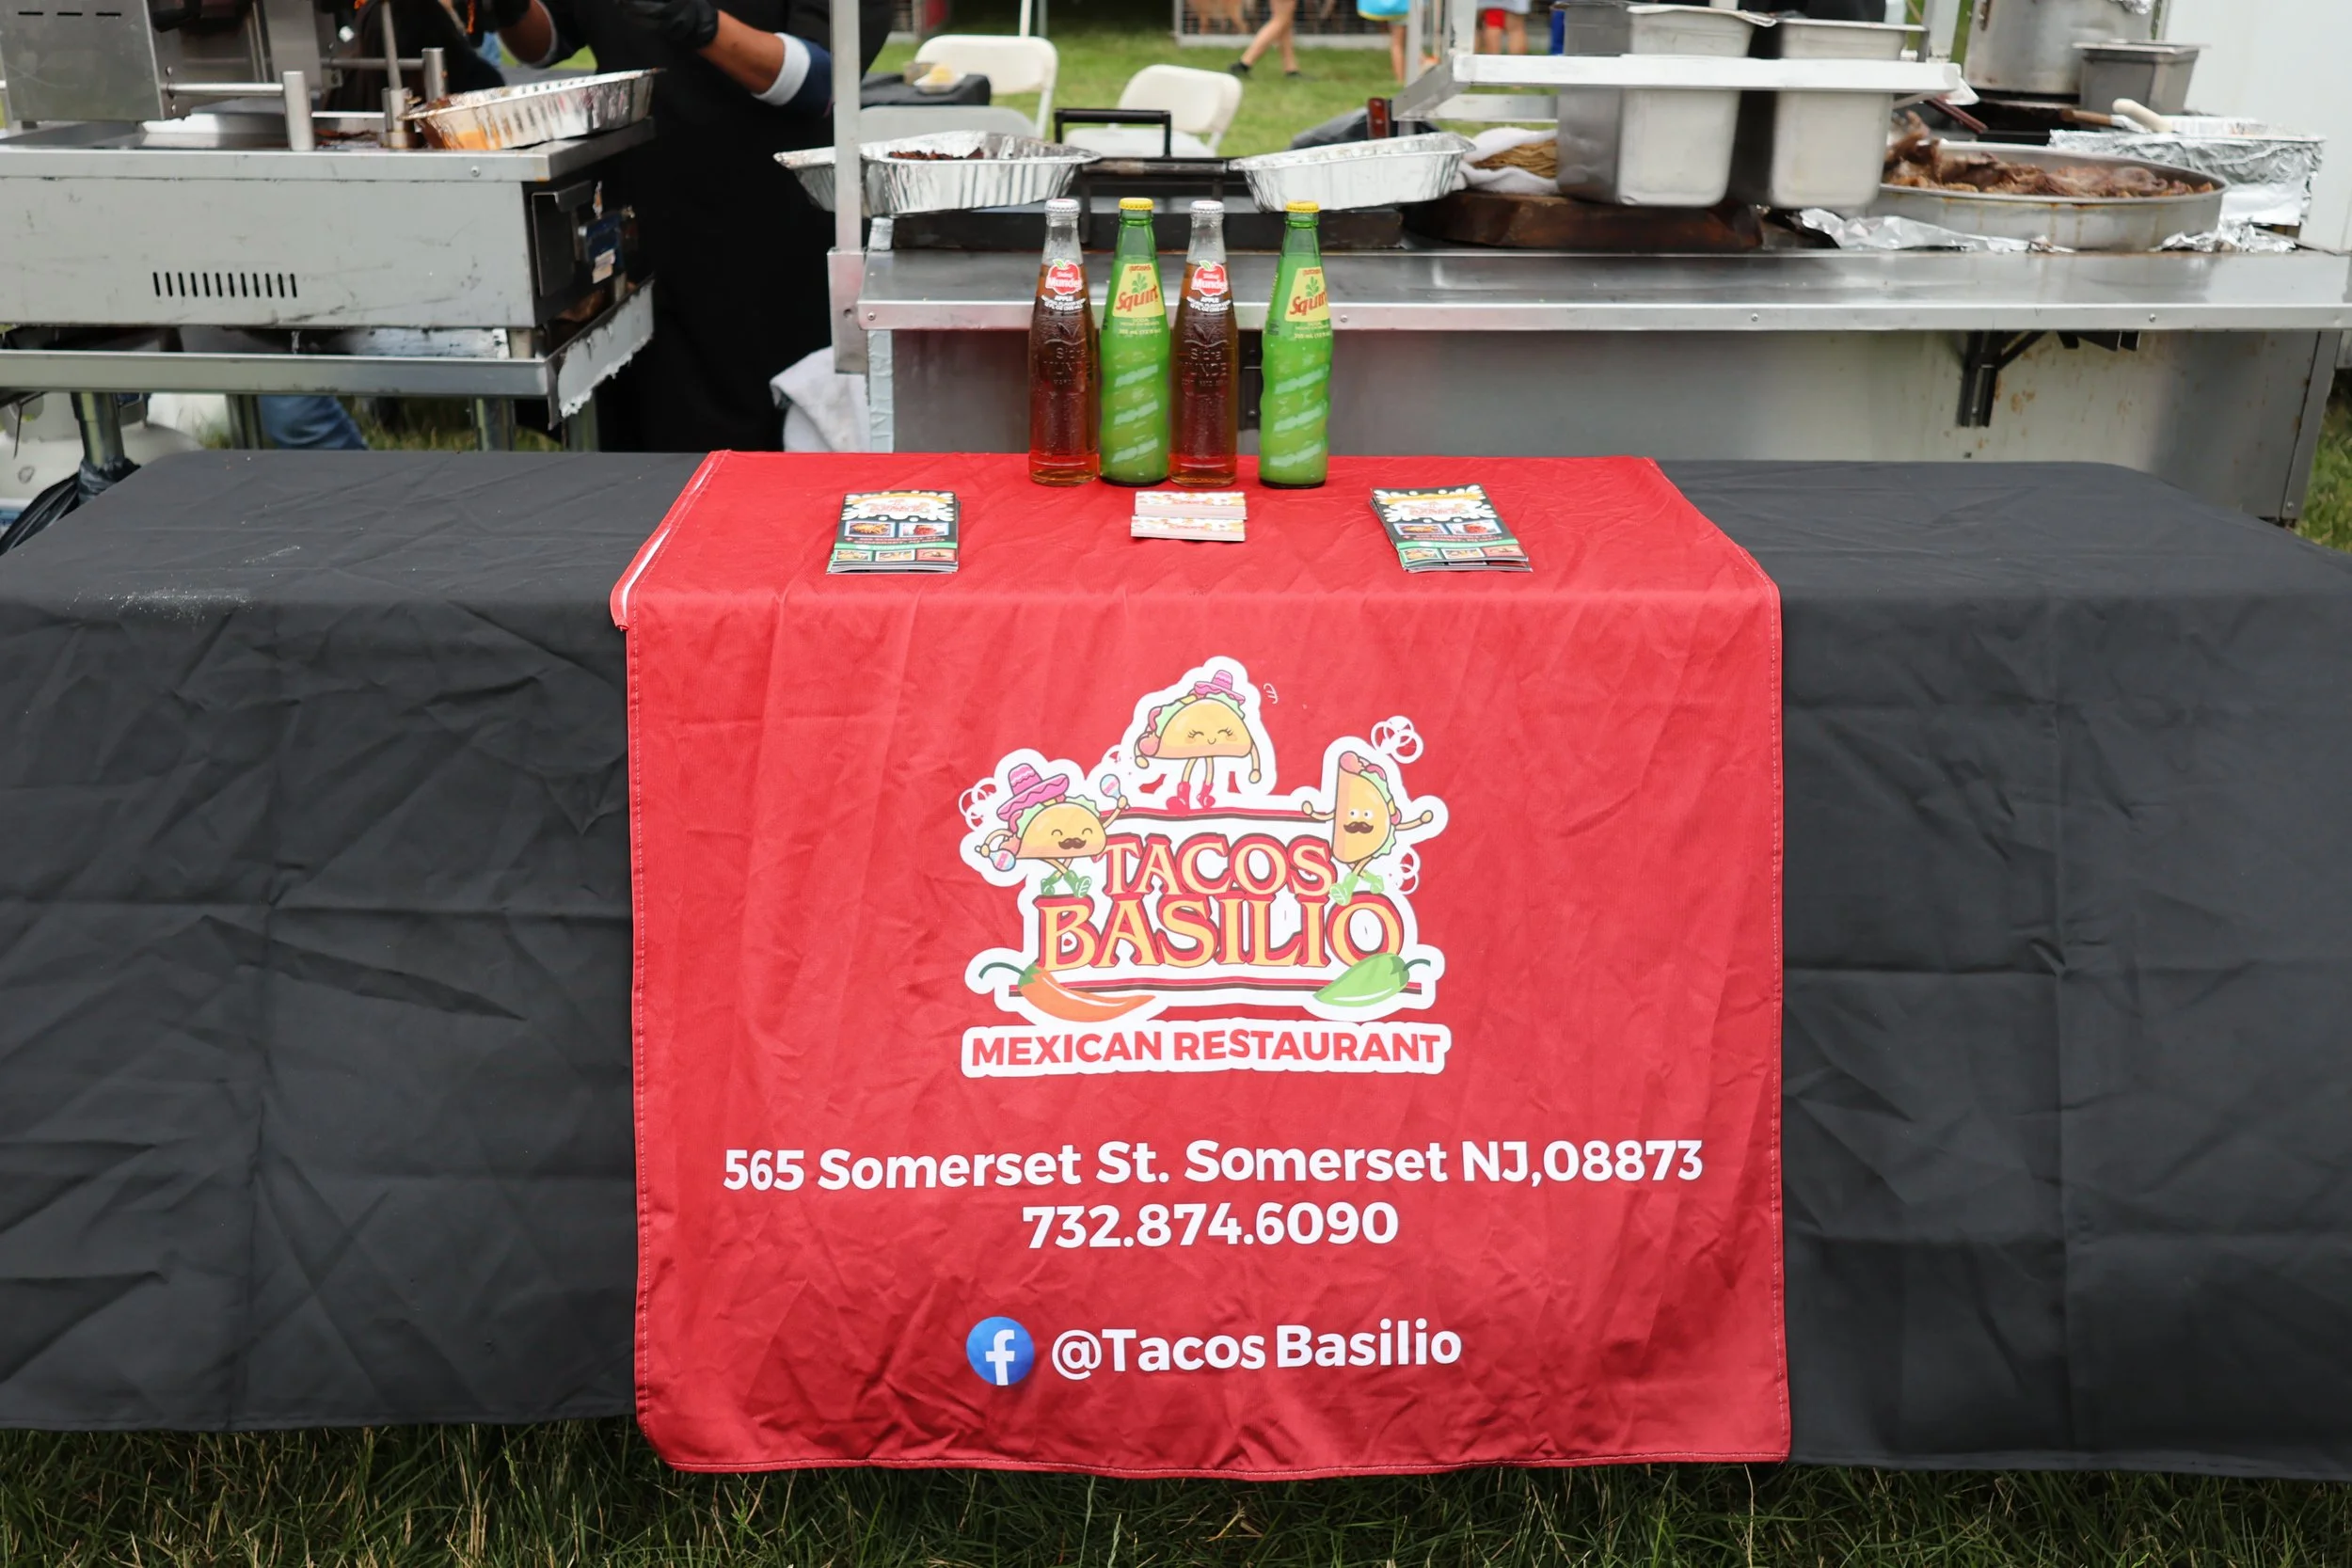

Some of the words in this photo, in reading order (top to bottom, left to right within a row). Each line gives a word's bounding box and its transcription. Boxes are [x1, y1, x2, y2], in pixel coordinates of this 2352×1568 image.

[1116, 285, 1158, 312] Squirt
[1094, 832, 1338, 895] TACOS
[1033, 891, 1405, 969] BASILIO
[972, 1031, 1162, 1067] MEXICAN
[1173, 1029, 1441, 1063] RESTAURANT
[723, 1149, 804, 1191] 565
[818, 1145, 1082, 1190] Somerset
[1096, 1141, 1169, 1184] St.
[1184, 1139, 1448, 1182] Somerset
[1462, 1140, 1703, 1187] NJ,08873
[1023, 1201, 1399, 1249] 732.874.6090
